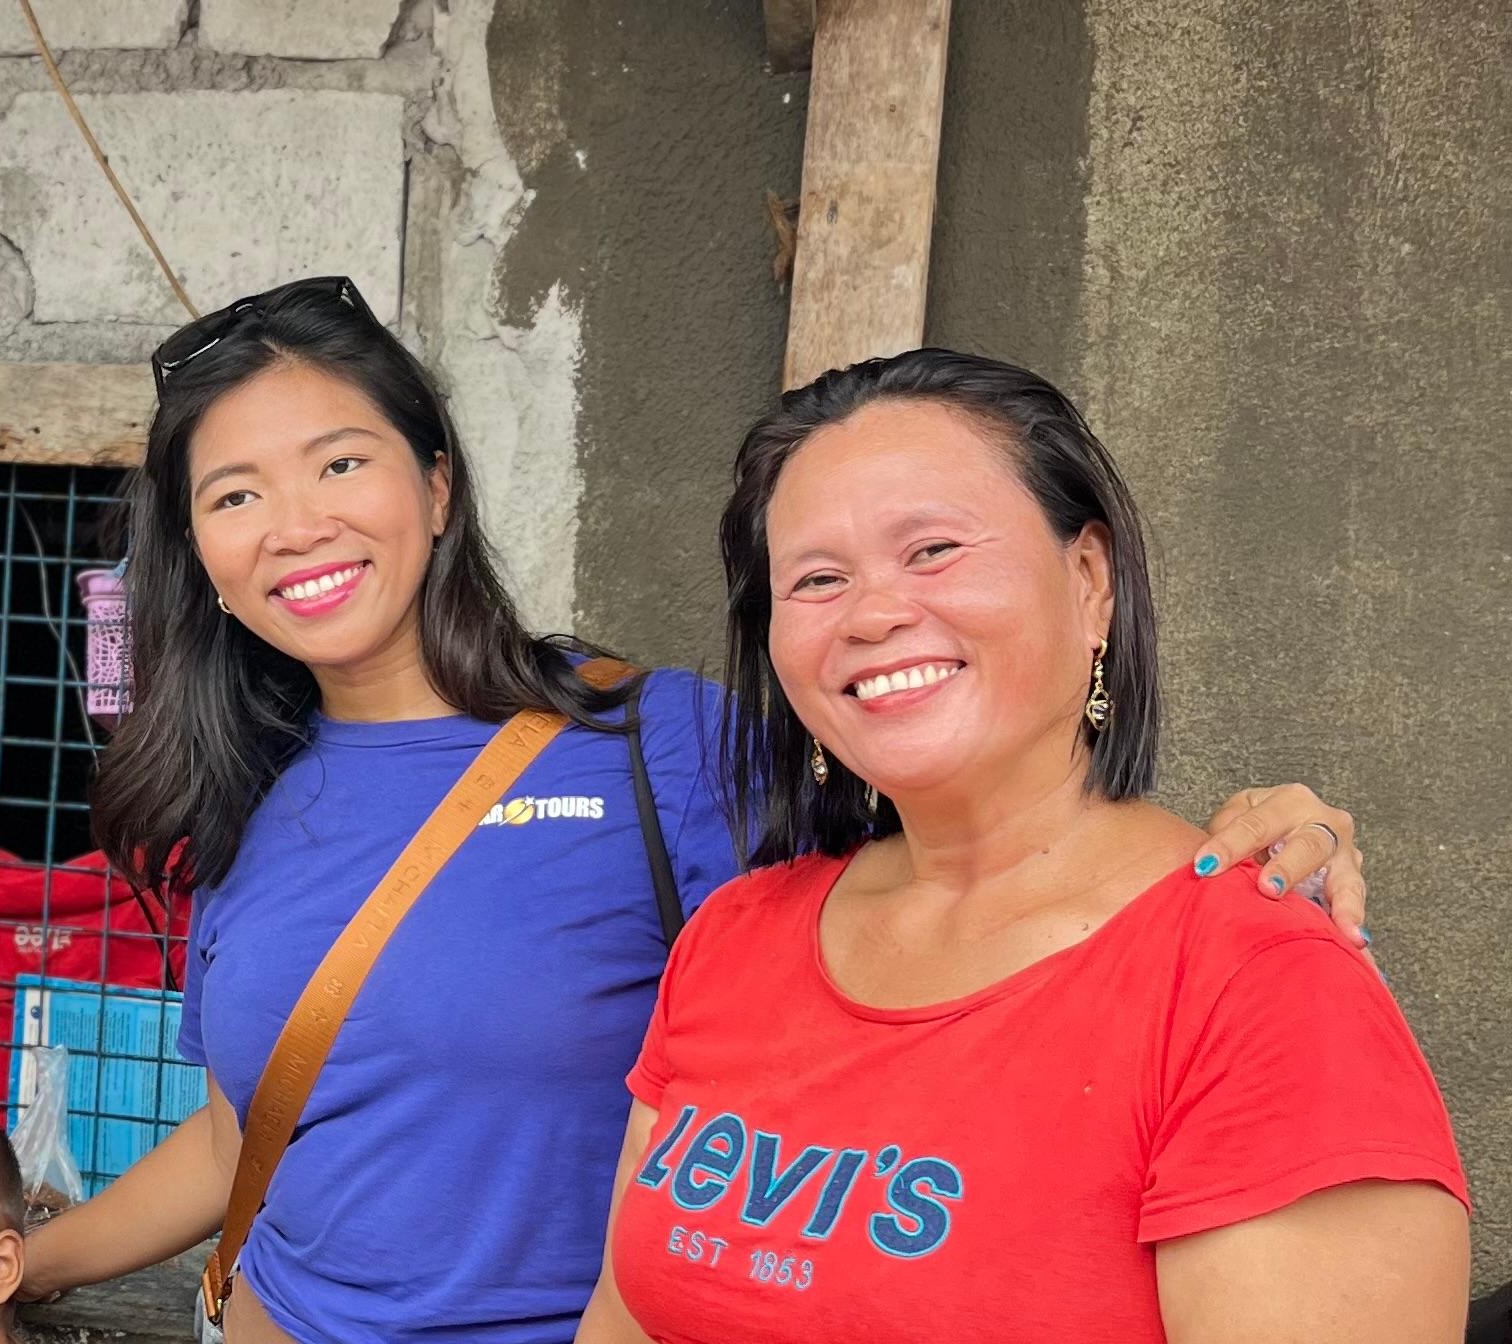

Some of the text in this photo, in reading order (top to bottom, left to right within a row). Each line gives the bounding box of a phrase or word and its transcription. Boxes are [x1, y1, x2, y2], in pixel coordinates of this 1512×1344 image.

[534, 796, 605, 820] TOURS
[667, 1225, 813, 1290] EST 1853
